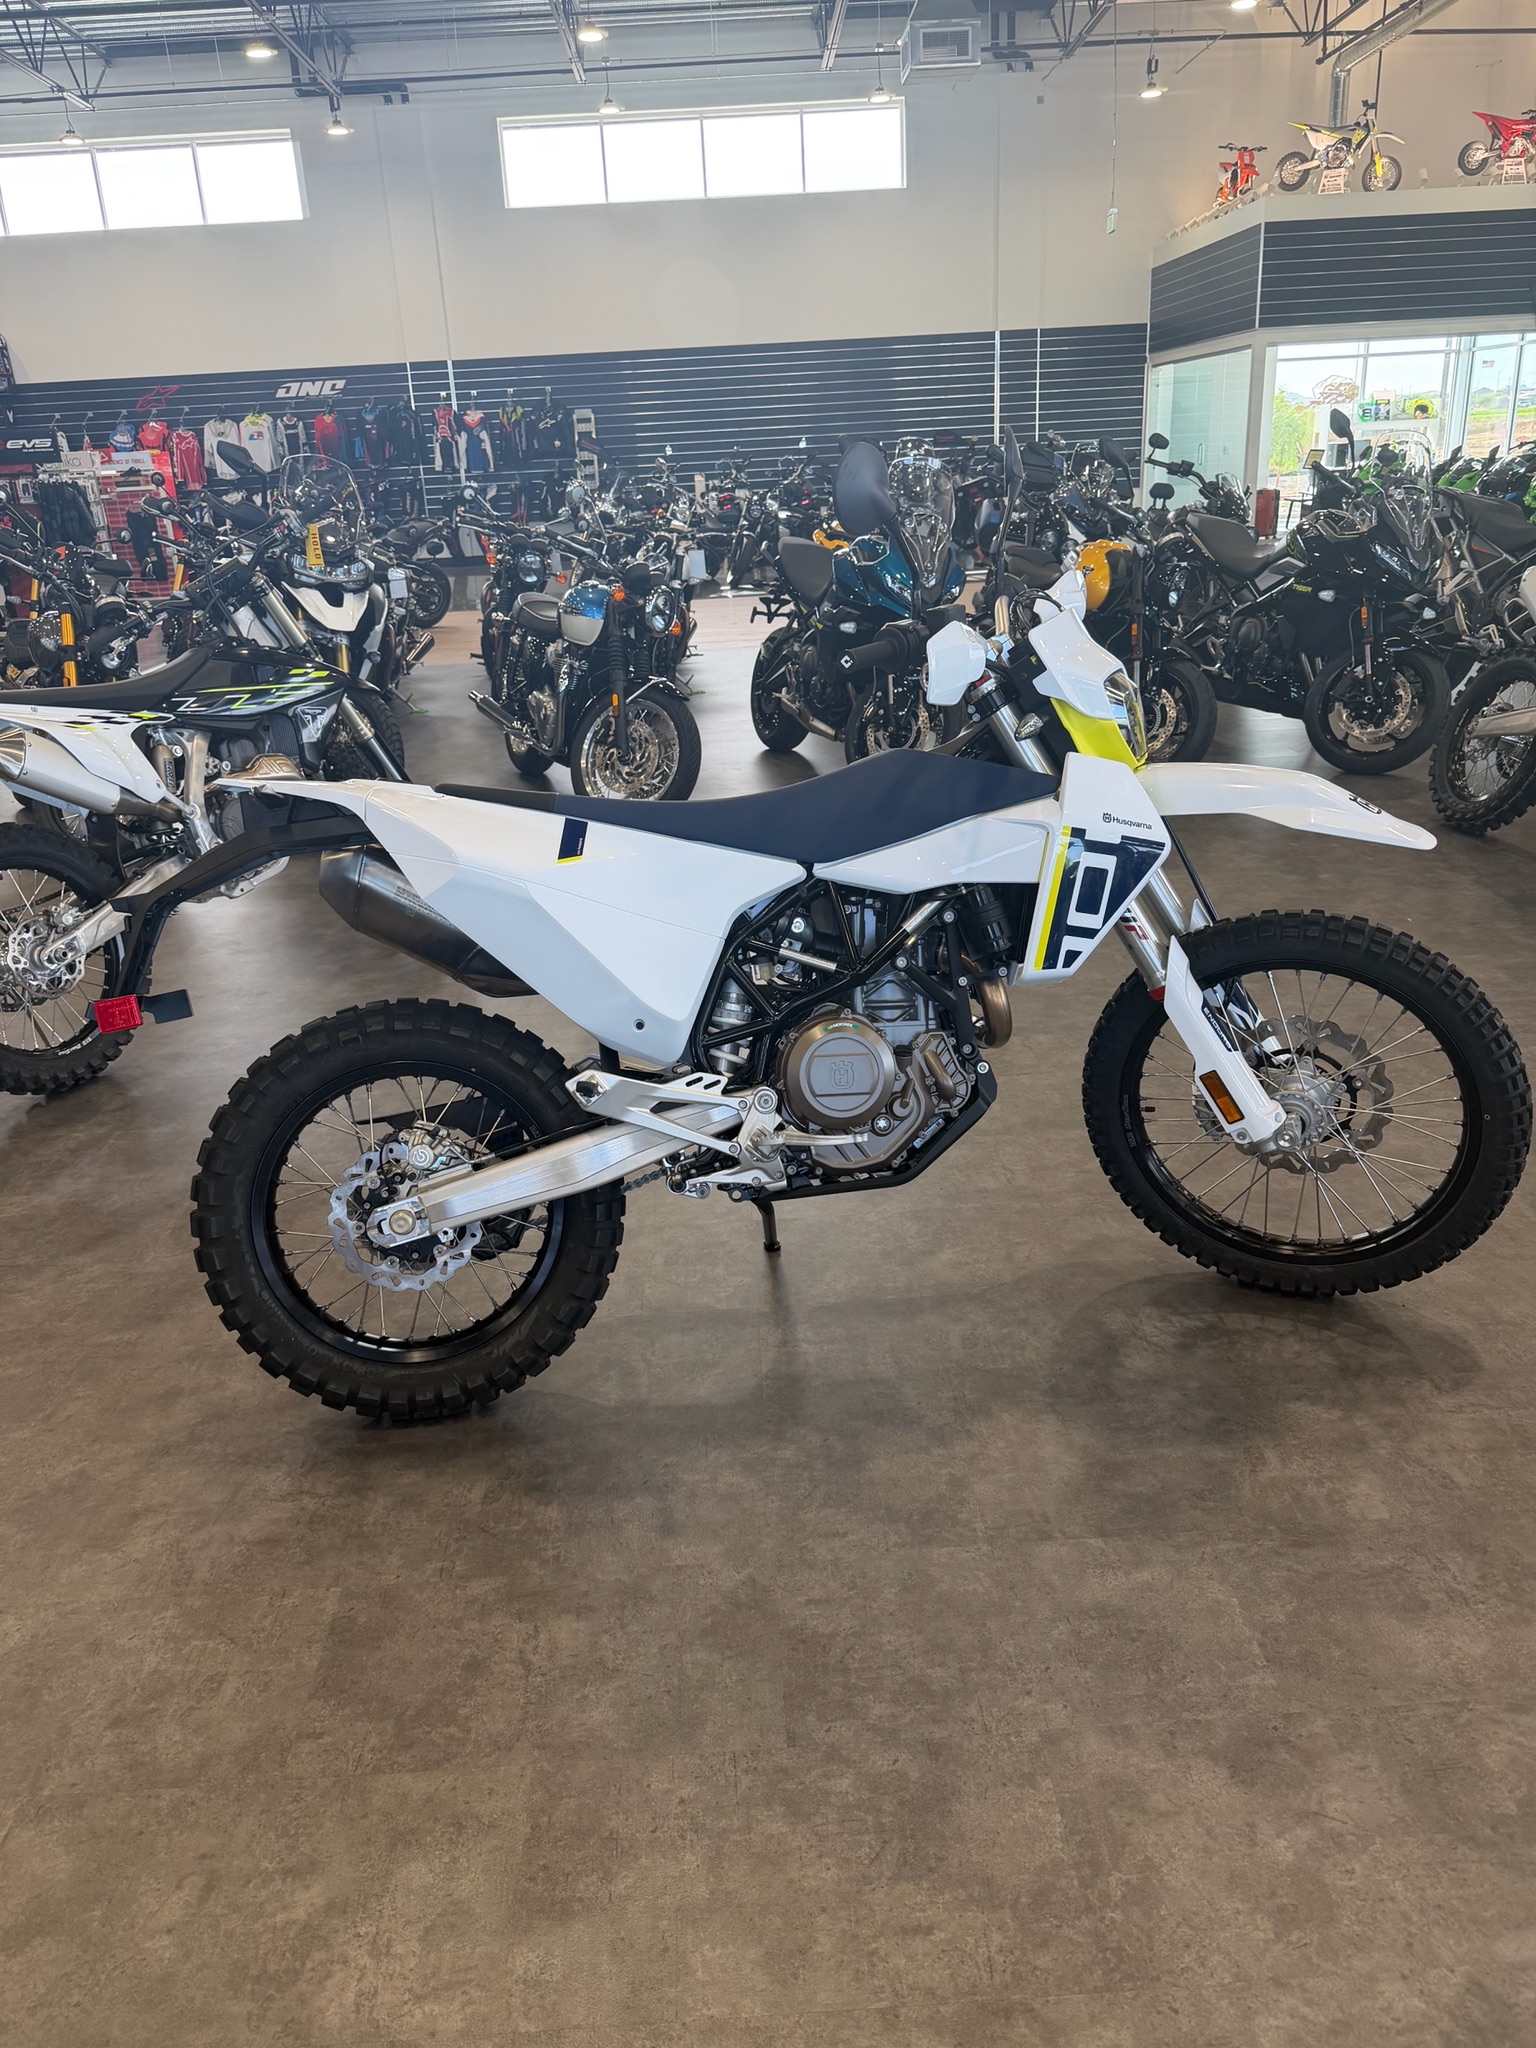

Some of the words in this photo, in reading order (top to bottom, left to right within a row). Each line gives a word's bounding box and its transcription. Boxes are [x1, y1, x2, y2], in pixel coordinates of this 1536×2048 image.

[310, 533, 321, 559] HOLD
[1292, 583, 1312, 593] TIGER
[1112, 816, 1152, 830] Husqvarna
[1203, 1006, 1232, 1049] ENDURO
